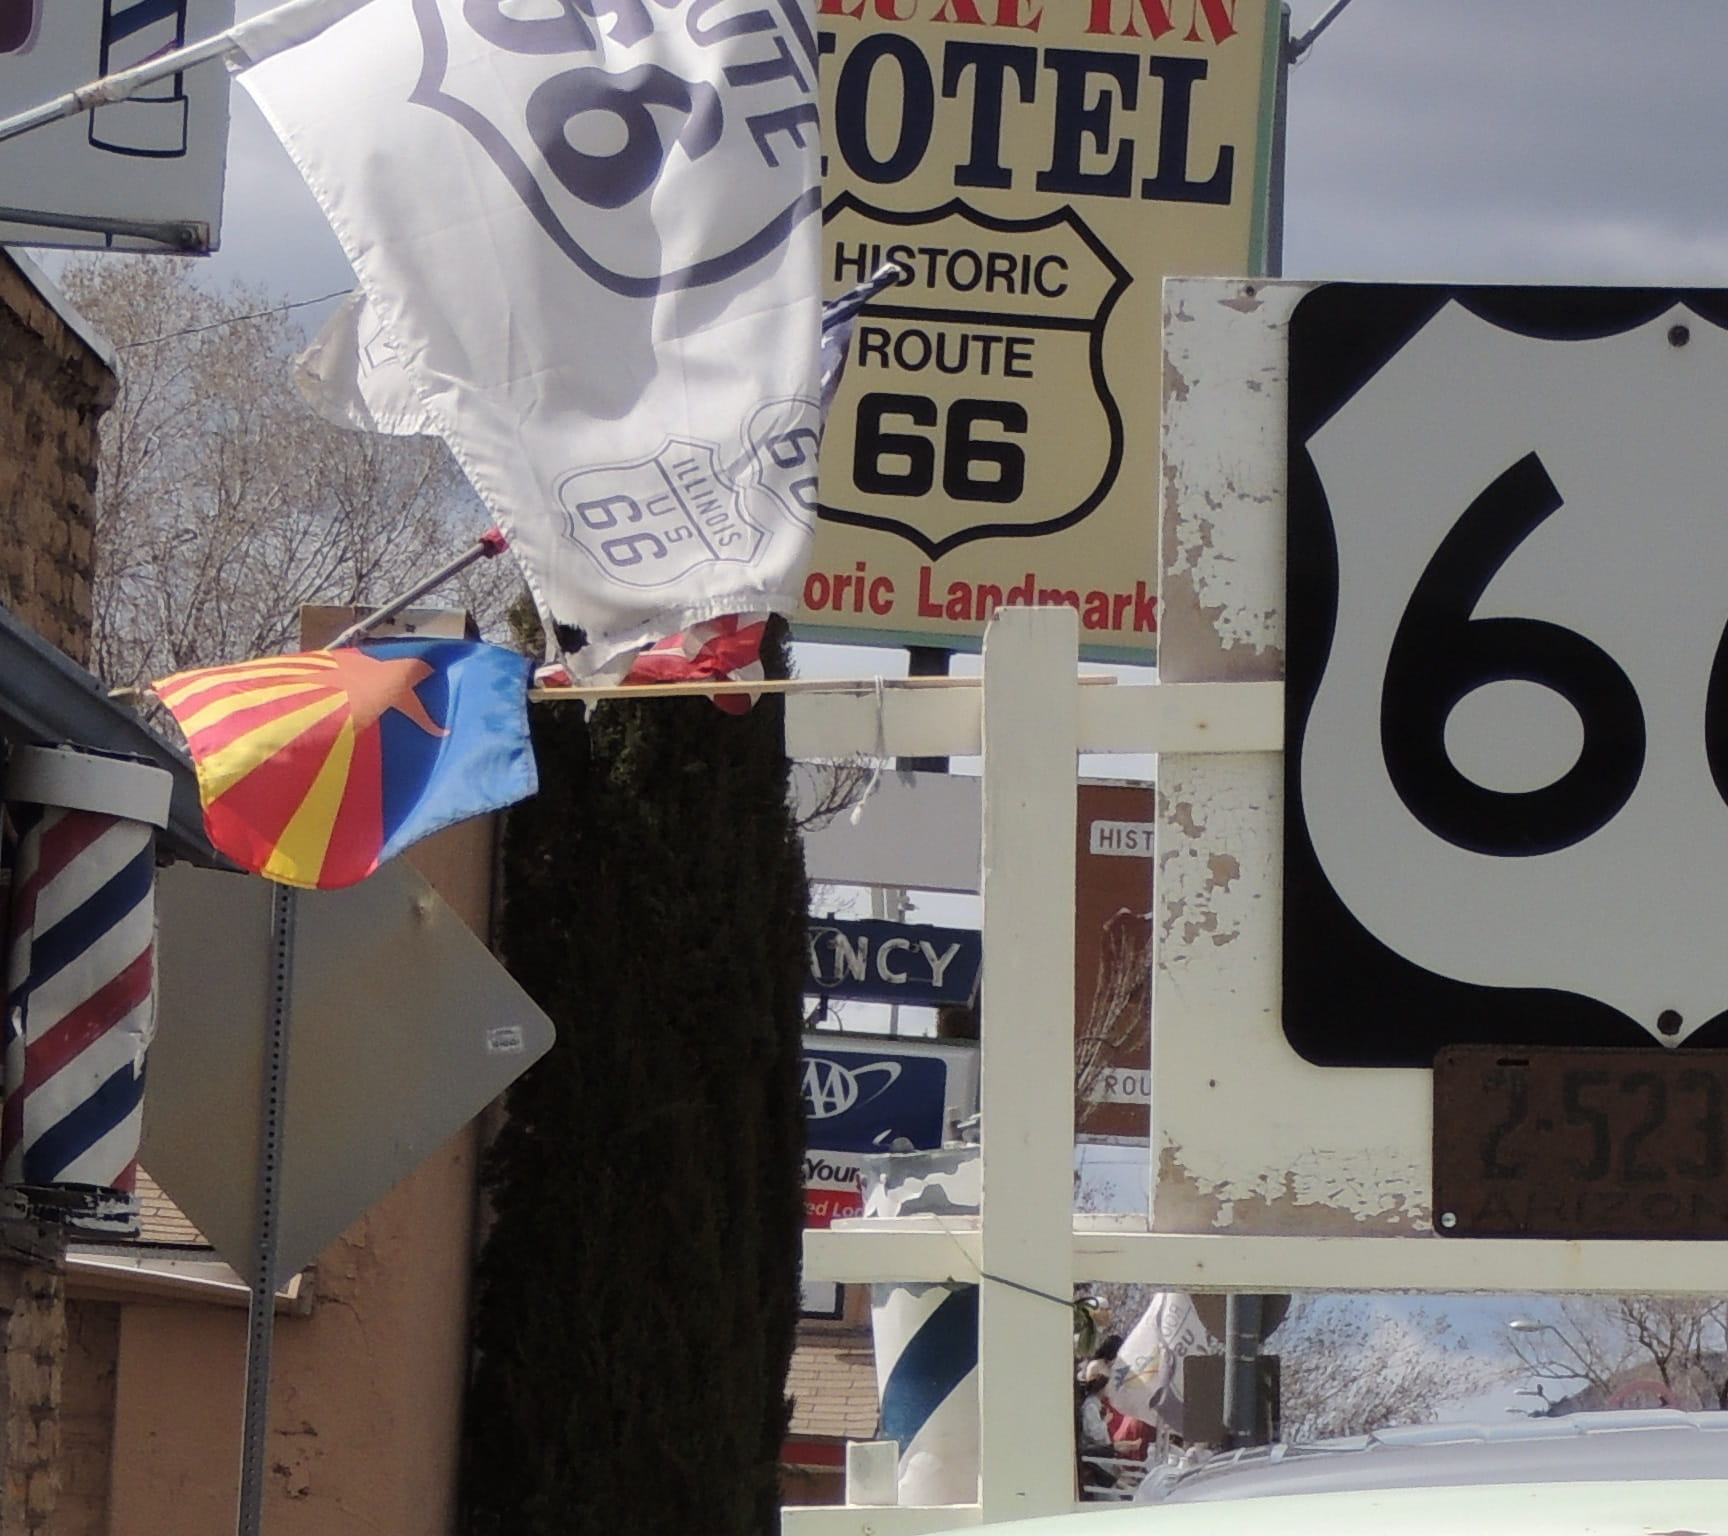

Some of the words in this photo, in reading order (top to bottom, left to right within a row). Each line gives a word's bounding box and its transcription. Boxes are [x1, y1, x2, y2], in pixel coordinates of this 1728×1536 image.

[818, 31, 1235, 206] OTEL
[834, 241, 1069, 298] HISTORIC
[858, 326, 1036, 378] ROUTE
[853, 392, 1028, 504] 66
[575, 494, 668, 567] 66
[671, 457, 743, 547] ILLINOIS
